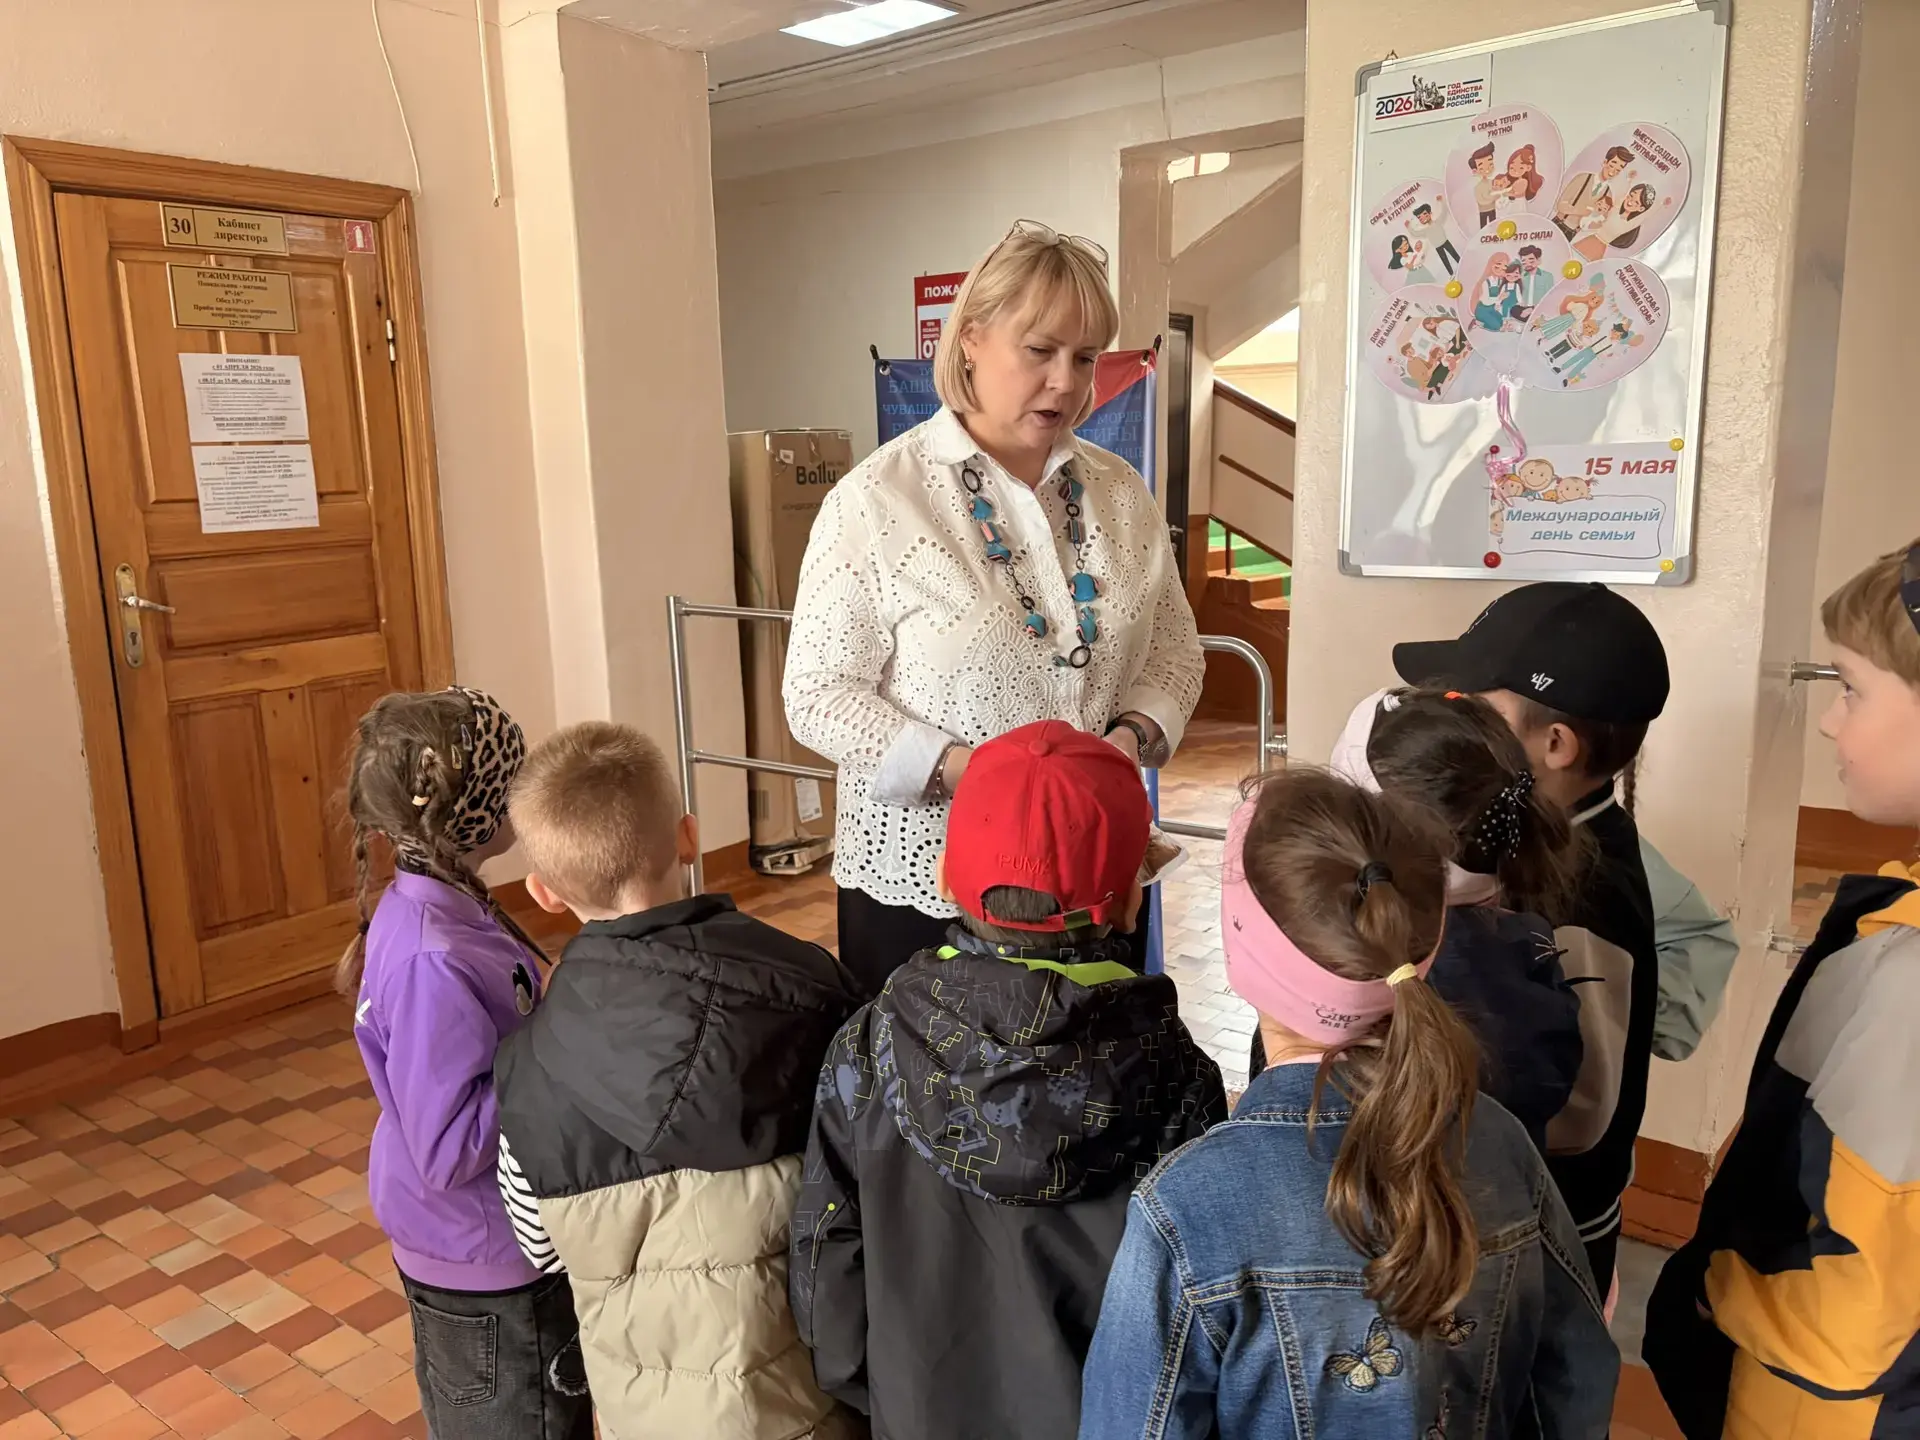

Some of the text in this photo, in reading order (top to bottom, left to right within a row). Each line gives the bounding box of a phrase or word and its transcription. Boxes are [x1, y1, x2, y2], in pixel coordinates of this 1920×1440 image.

[1447, 82, 1461, 90] ГОД
[1447, 85, 1482, 96] ЕДИНСТВА
[1446, 92, 1479, 102] НАРОДОВ
[1446, 99, 1475, 108] РОССИИ
[1376, 96, 1413, 116] 2026
[1471, 111, 1528, 133] В СЕМЬЕ ТЕПЛО И
[1633, 128, 1657, 149] ВМЕСТЕ
[1392, 182, 1421, 207] ЛЕСТНИЦА
[170, 217, 191, 234] 30
[217, 217, 261, 231] Кабинет
[213, 231, 268, 244] директора
[197, 271, 267, 283] РЕЖИМ РАБОТЫ
[924, 284, 960, 298] ПОЖА
[1370, 328, 1381, 344] ДОМ
[1382, 311, 1392, 324] ЭТО
[1390, 297, 1401, 311] ТАМ
[1376, 336, 1387, 348] ГДЕ
[888, 380, 936, 393] БАШК
[1097, 411, 1145, 425] МОРДВ
[796, 460, 837, 485] Ballu
[1585, 457, 1677, 475] 15 мая
[1505, 507, 1661, 524] Международный
[1530, 530, 1635, 541] день семьи
